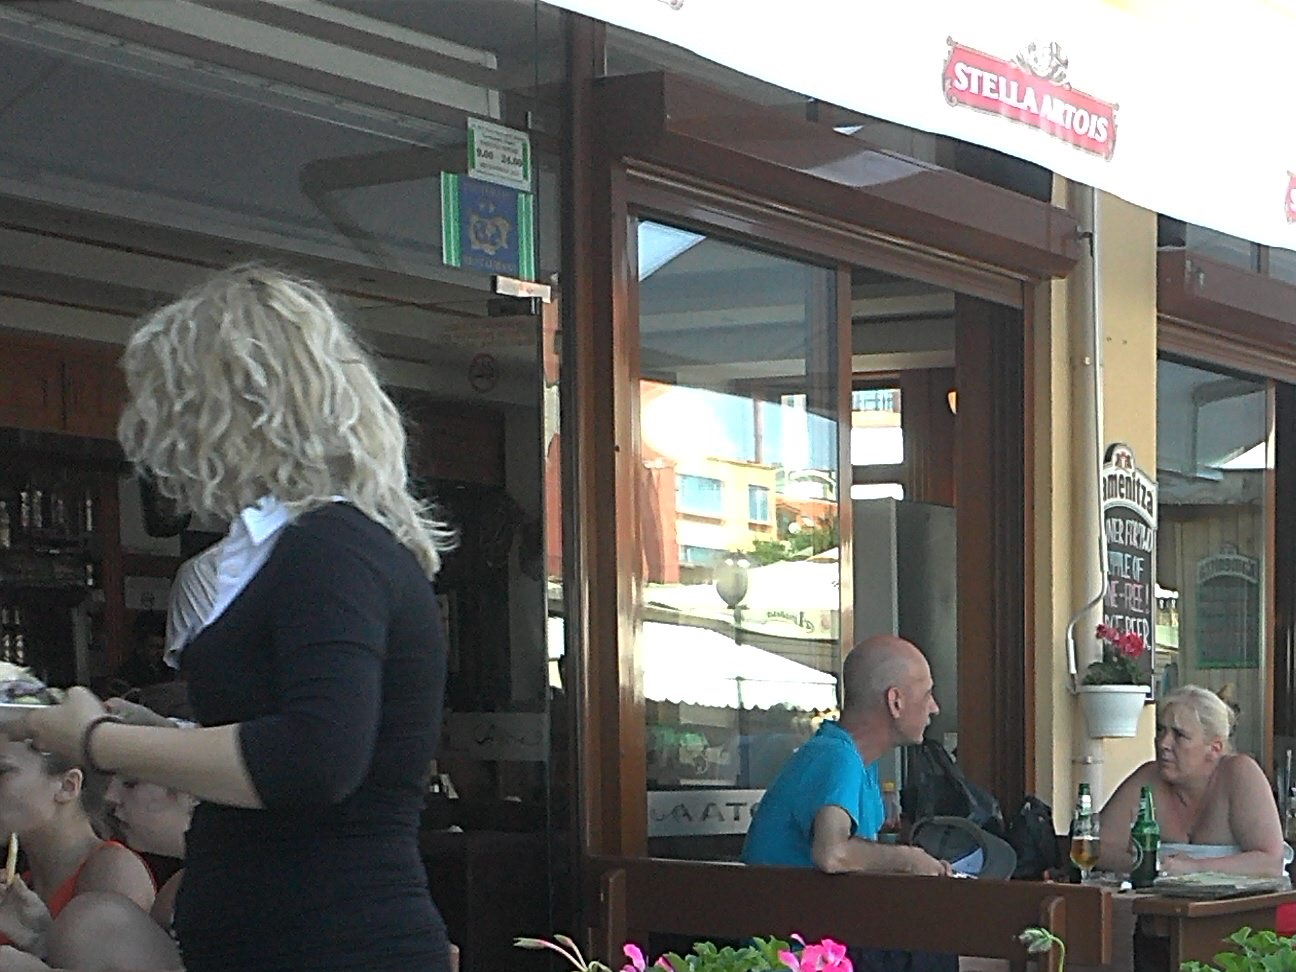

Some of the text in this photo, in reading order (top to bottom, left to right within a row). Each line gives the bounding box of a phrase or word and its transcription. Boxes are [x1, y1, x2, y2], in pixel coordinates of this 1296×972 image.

[953, 61, 1110, 144] STELLA ARTOIS
[1102, 471, 1154, 515] amenitza
